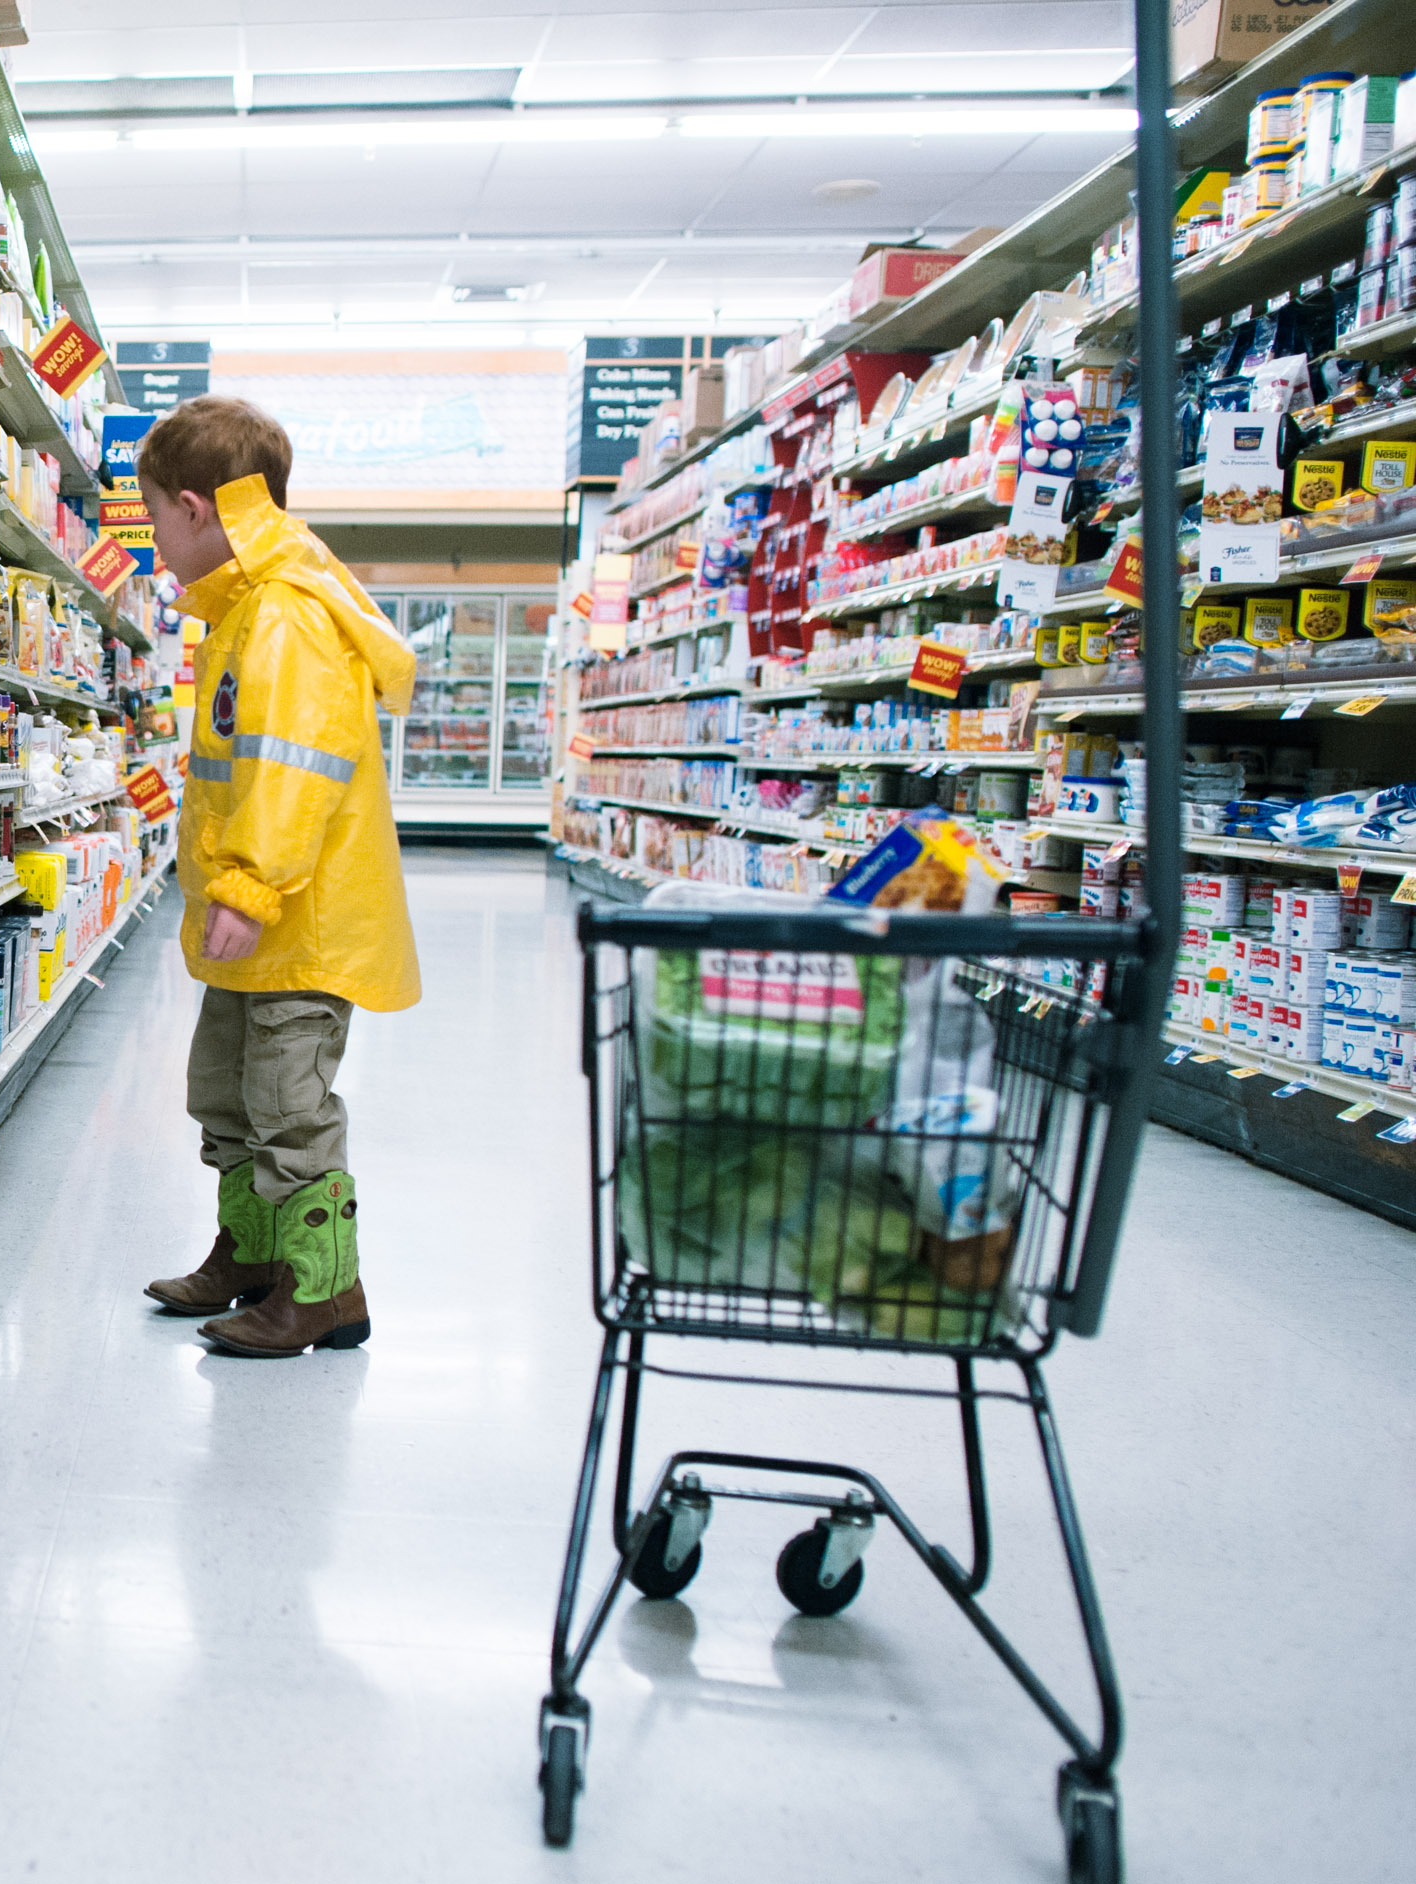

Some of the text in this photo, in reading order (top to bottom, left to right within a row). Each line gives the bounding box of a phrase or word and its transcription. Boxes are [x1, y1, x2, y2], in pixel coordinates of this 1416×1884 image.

[41, 332, 82, 375] WOW!
[153, 343, 168, 361] 3
[623, 338, 639, 357] 3
[56, 344, 85, 378] savings
[626, 405, 659, 419] Frui
[1375, 470, 1403, 478] HOUSE
[1381, 463, 1400, 471] TOLL
[120, 530, 151, 539] PRICE
[87, 545, 120, 578] WOW!
[922, 653, 960, 674] WOW!
[131, 773, 160, 795] WOW!
[843, 848, 897, 896] Blueberry
